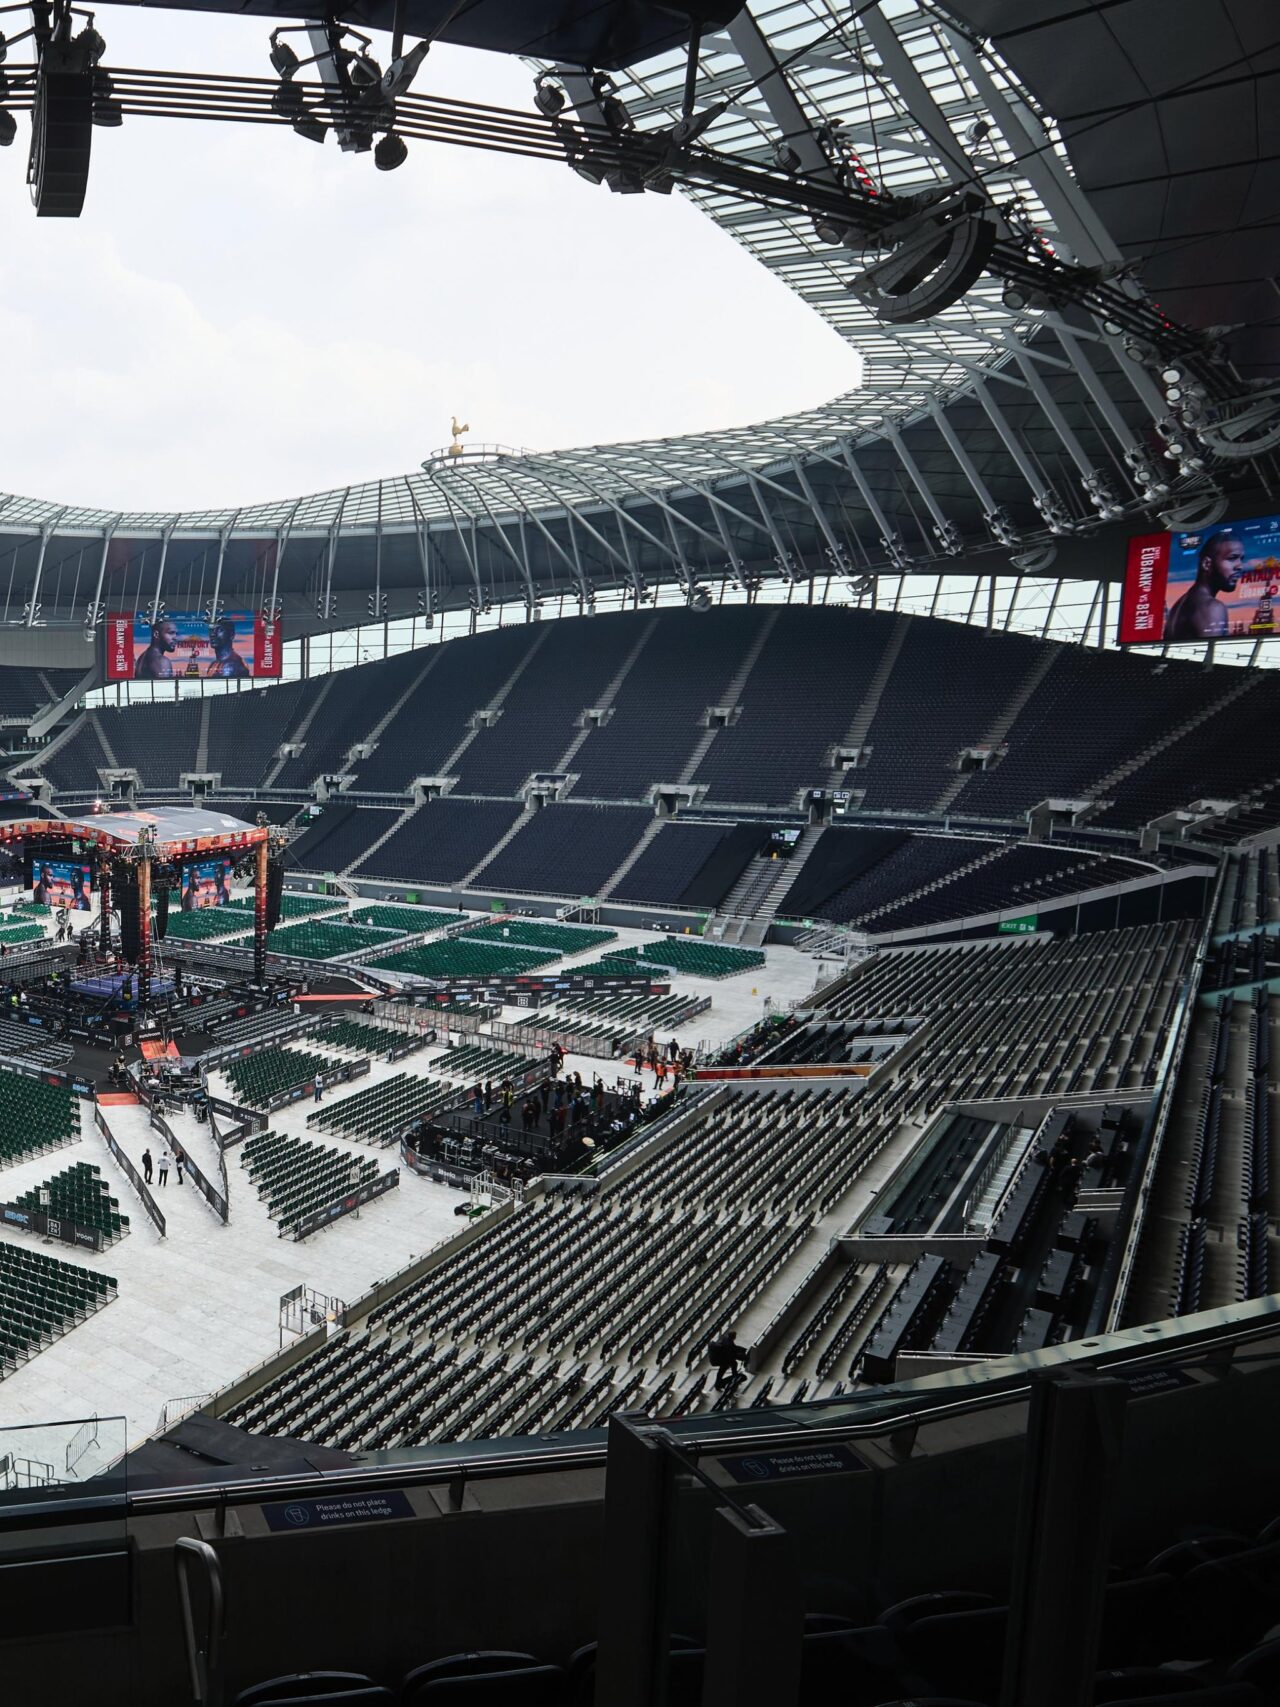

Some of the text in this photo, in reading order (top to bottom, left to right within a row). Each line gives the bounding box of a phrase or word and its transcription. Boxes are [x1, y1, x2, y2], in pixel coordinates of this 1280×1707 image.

[1138, 547, 1155, 588] EUBANK
[1134, 603, 1150, 630] BENN
[815, 1453, 834, 1461] place
[779, 1464, 801, 1472] drinks
[824, 1460, 843, 1469] ledge
[366, 1498, 387, 1507] place
[320, 1512, 344, 1520] drinks
[355, 1508, 371, 1516] this
[370, 1507, 392, 1515] ledge
